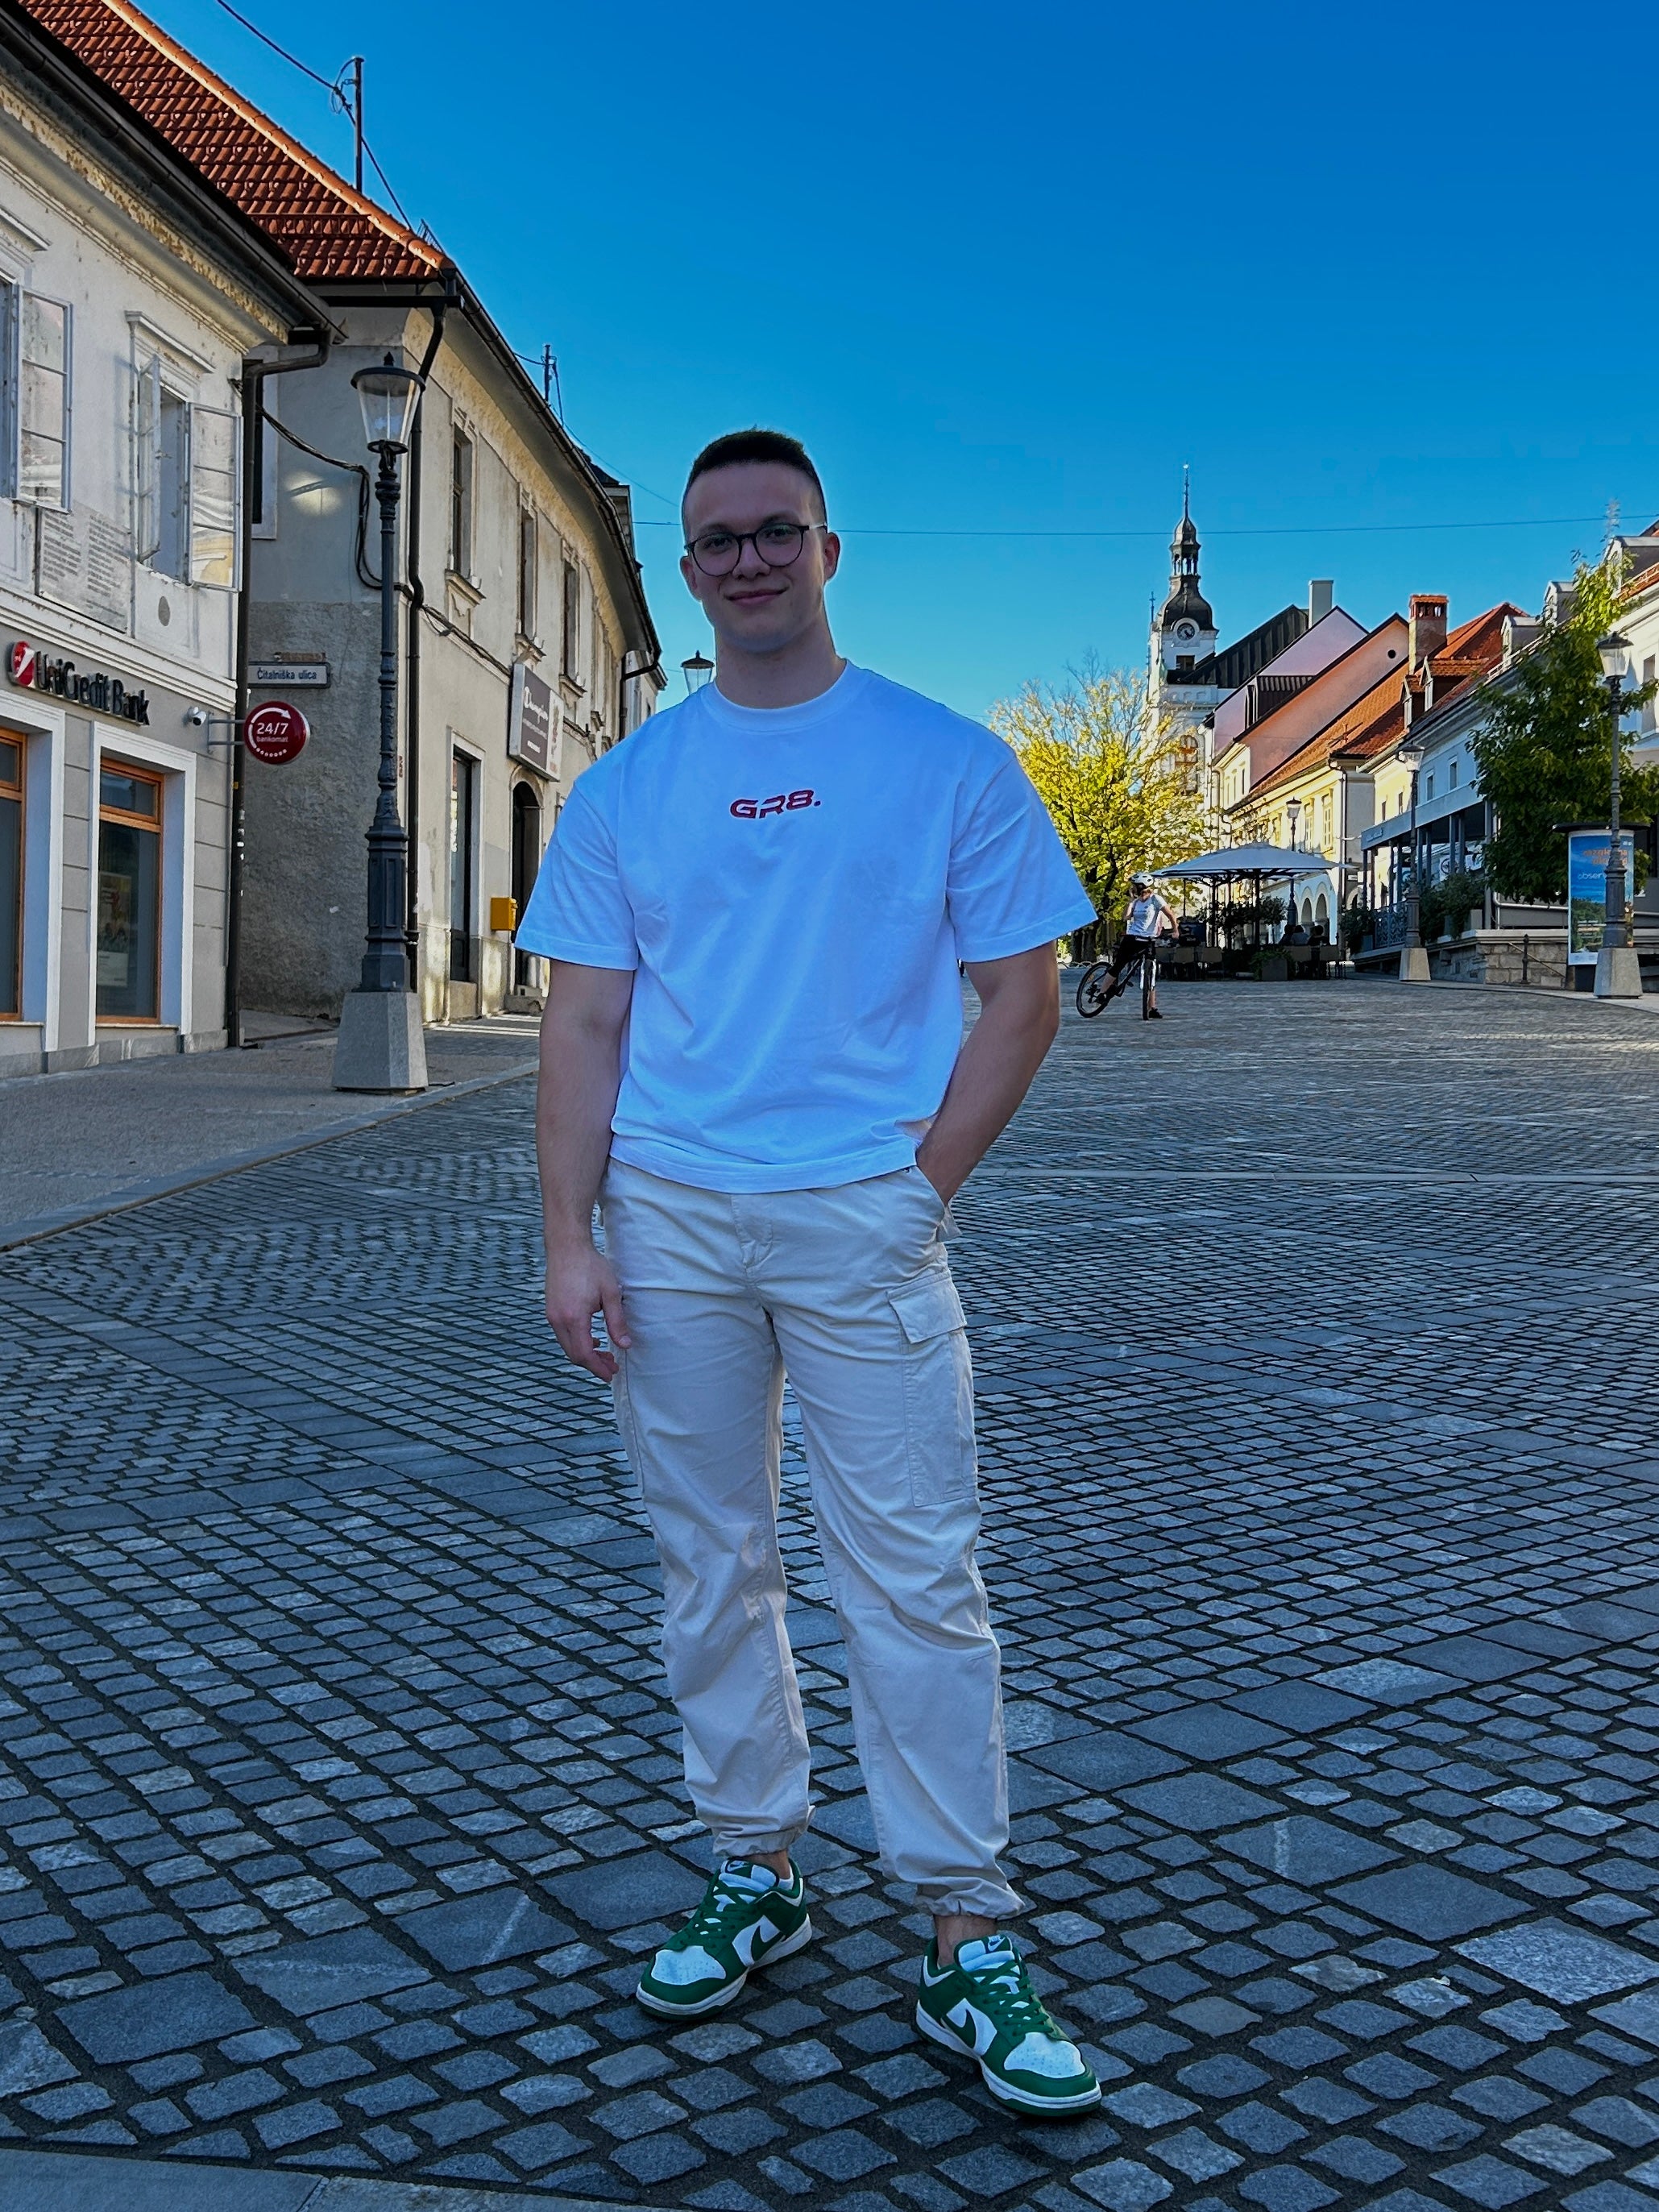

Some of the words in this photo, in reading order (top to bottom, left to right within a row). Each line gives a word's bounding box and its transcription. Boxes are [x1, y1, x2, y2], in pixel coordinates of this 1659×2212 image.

[298, 670, 317, 680] ulica
[36, 650, 111, 712] UniCredit
[112, 679, 150, 725] Bank
[257, 722, 288, 735] 24/7
[730, 789, 821, 819] GR8.
